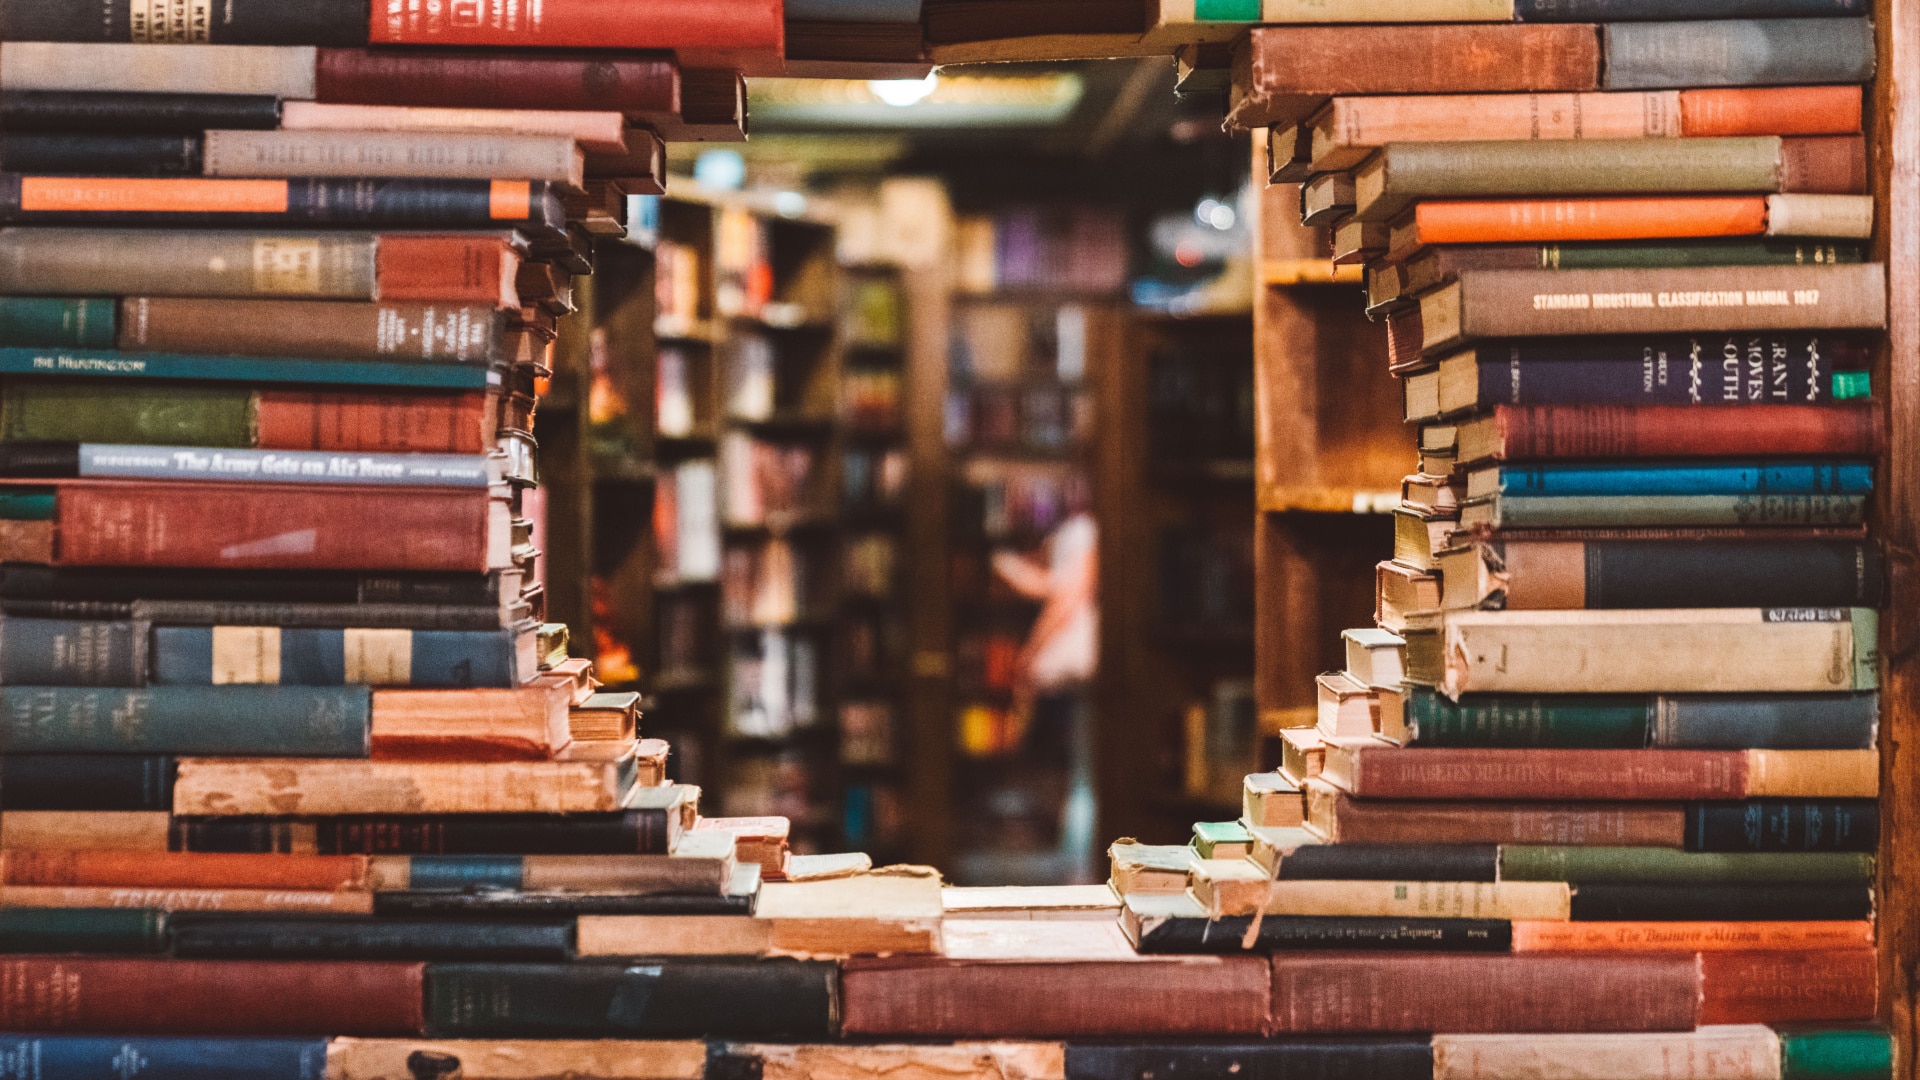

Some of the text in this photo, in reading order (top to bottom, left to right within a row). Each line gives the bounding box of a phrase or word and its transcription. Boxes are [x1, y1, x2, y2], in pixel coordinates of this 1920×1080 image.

[155, 3, 165, 40] LAST
[193, 6, 205, 41] MAN
[1533, 294, 1590, 310] STANDARD
[1592, 292, 1655, 309] INDUSTRIAL
[1657, 290, 1743, 308] CLASSIFICATION
[1745, 289, 1790, 306] MANUAL
[58, 355, 147, 372] HUNTINGTON
[1723, 337, 1738, 400] OUTH
[1772, 341, 1788, 401] RANT
[173, 452, 209, 471] The
[209, 453, 259, 475] Army
[261, 453, 301, 474] Gets
[302, 460, 325, 475] an
[327, 457, 357, 476] Air
[359, 457, 404, 478] Force
[1400, 925, 1444, 940] Planning
